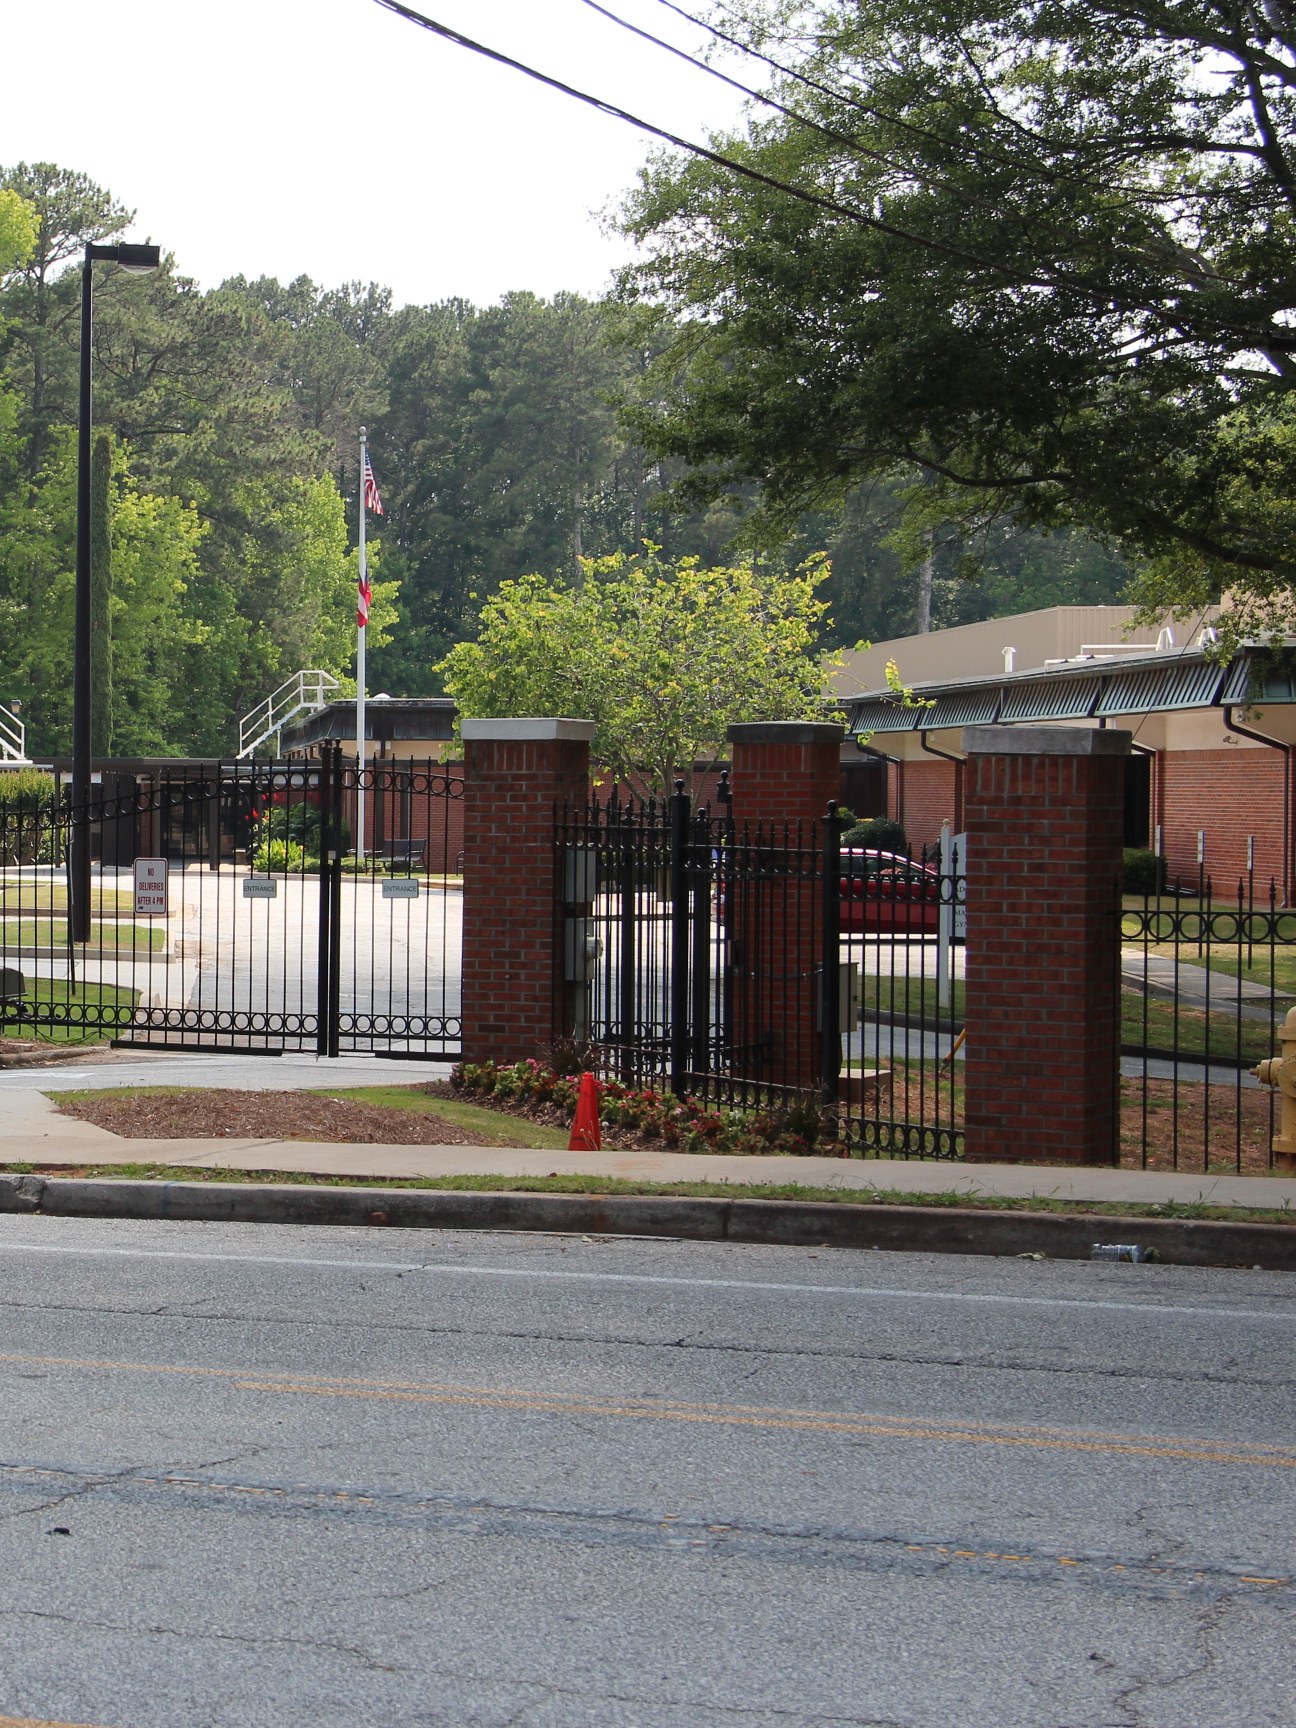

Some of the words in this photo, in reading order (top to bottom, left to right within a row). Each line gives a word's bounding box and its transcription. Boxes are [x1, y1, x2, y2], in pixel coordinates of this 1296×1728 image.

[147, 867, 155, 876] NO
[138, 882, 164, 891] DELIVERIES
[137, 896, 151, 905] AFTER
[156, 896, 164, 905] PM
